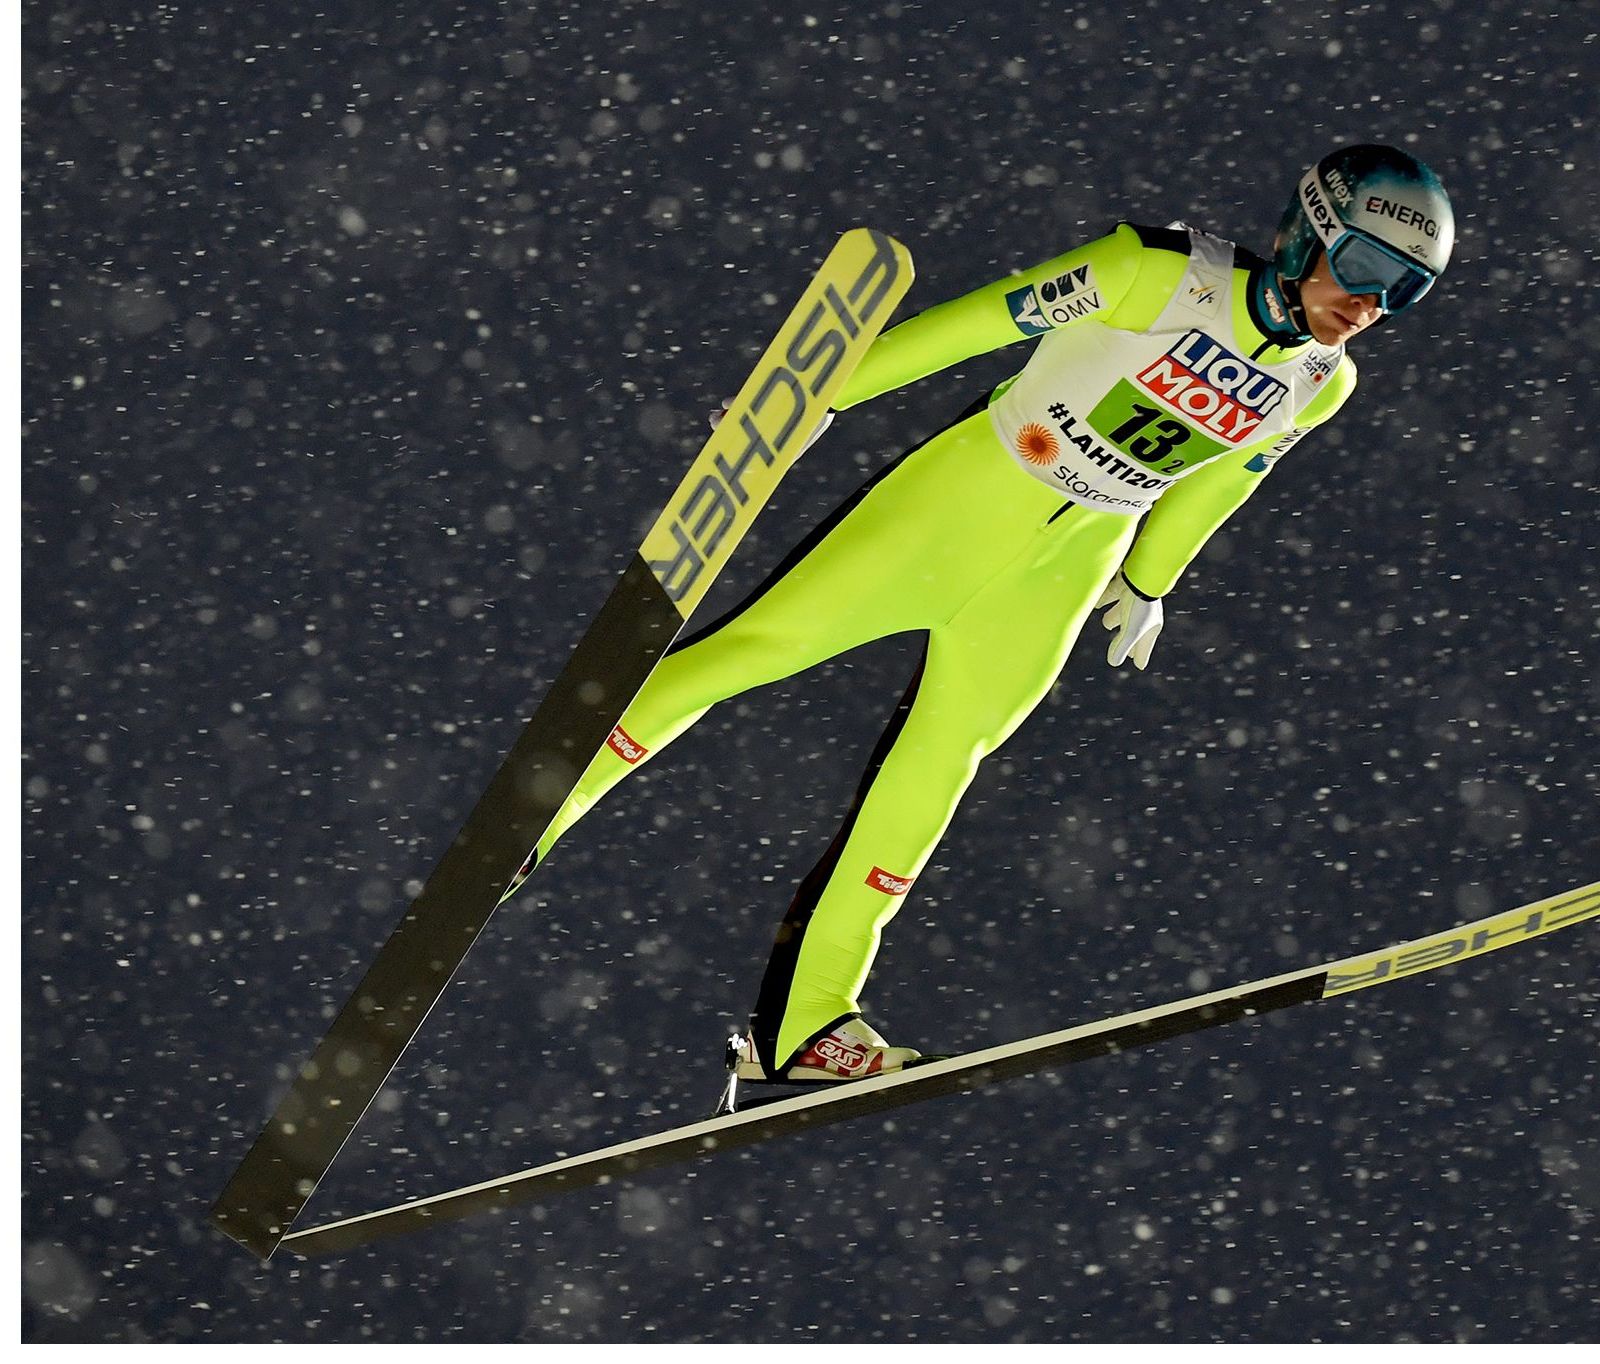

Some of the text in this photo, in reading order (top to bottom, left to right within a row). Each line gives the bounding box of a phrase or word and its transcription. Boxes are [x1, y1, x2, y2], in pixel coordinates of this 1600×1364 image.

[1304, 182, 1336, 237] uvex
[1325, 168, 1353, 207] uvex
[1052, 292, 1100, 323] OMV
[1140, 359, 1261, 440] MOLY
[1170, 333, 1287, 413] LIQUI
[647, 228, 899, 601] FISCHER
[1108, 403, 1191, 473] 13 2
[820, 1043, 861, 1069] RASS
